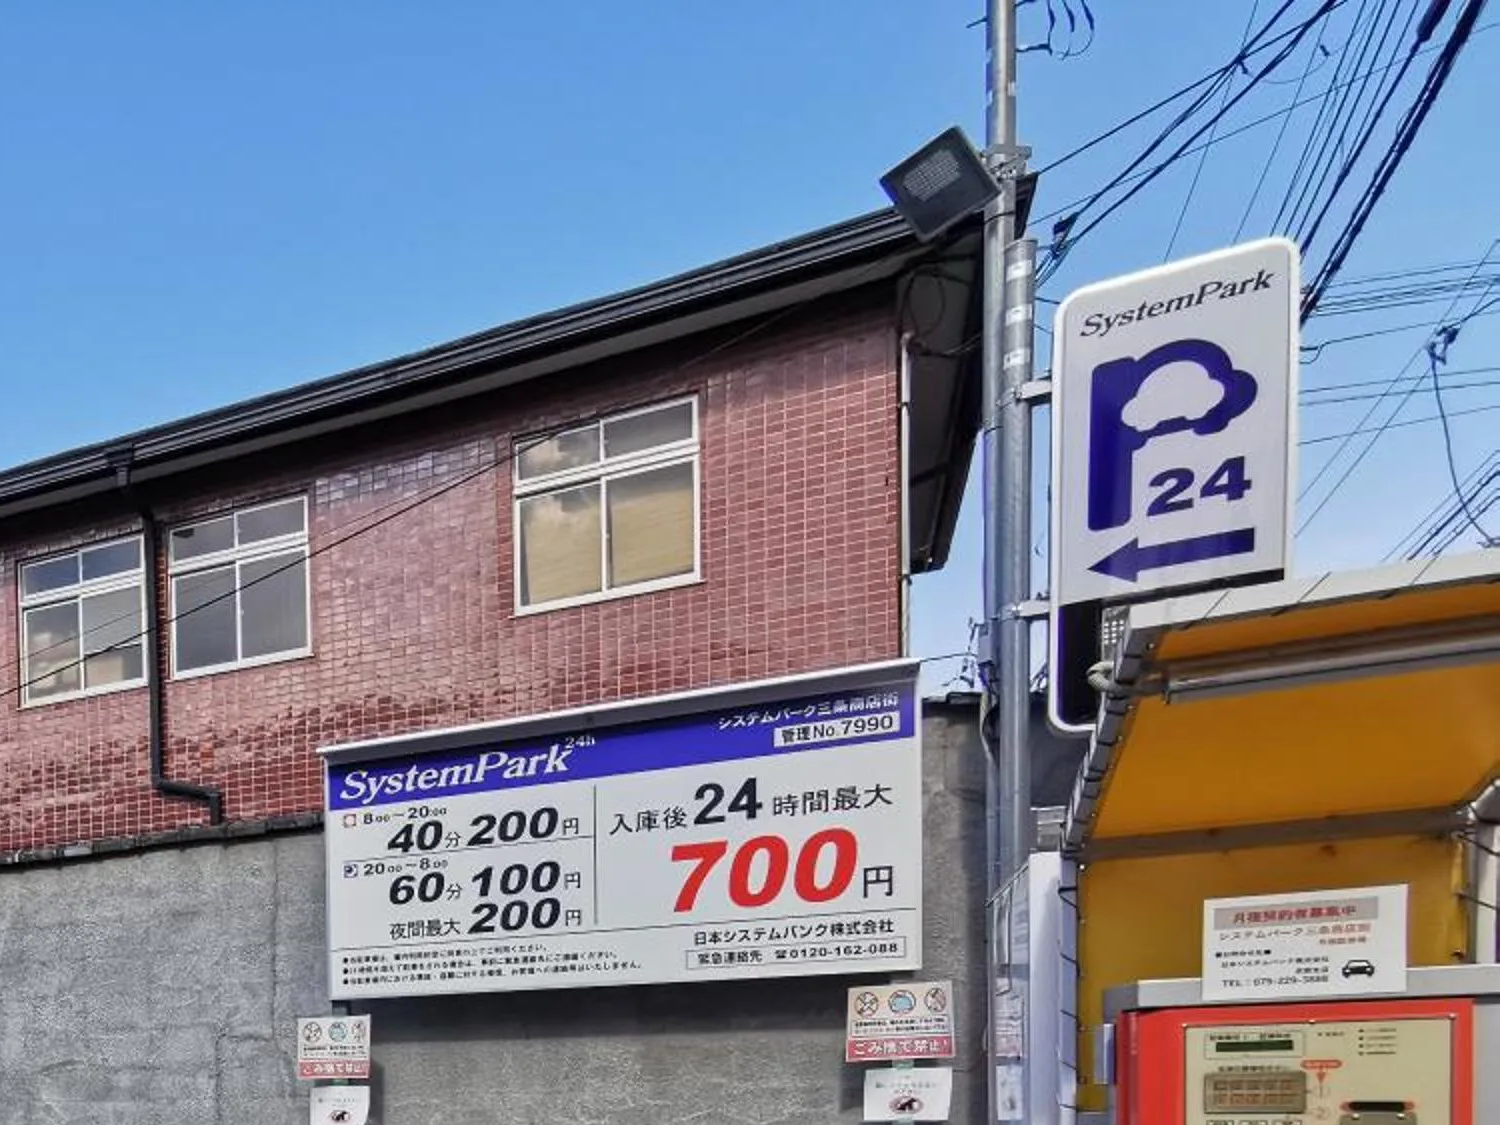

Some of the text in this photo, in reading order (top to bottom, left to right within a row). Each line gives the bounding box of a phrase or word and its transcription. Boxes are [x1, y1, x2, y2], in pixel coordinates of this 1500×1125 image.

[1079, 269, 1277, 337] SystemPark
[1146, 455, 1254, 518] 24
[340, 744, 572, 804] SystemPark
[466, 807, 580, 847] 200円
[471, 861, 581, 897] 100円
[671, 827, 894, 913] 700円
[389, 897, 582, 940] 夜間最大 200円
[694, 919, 895, 945] 日本システムバンク株式会社
